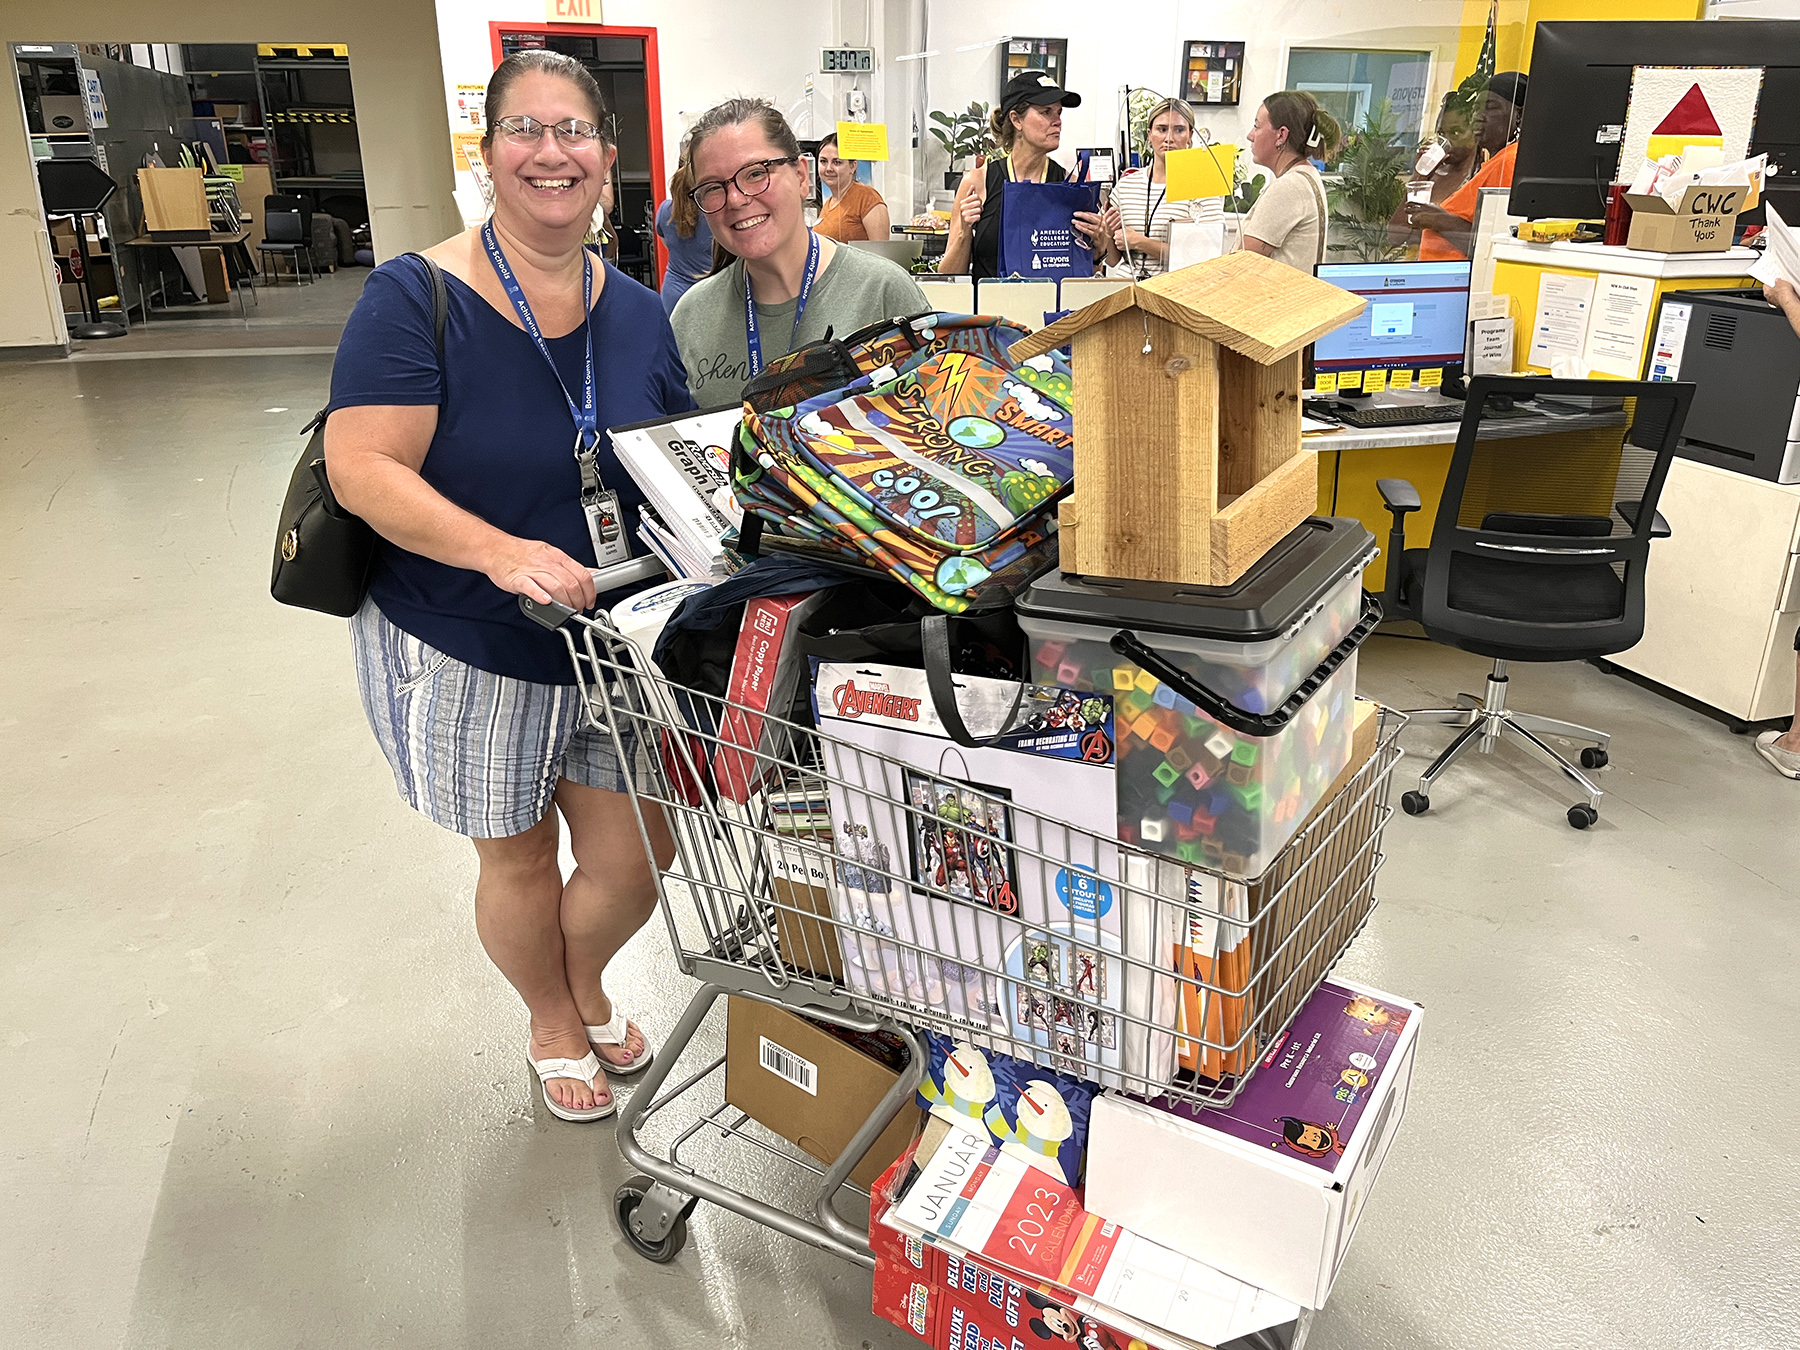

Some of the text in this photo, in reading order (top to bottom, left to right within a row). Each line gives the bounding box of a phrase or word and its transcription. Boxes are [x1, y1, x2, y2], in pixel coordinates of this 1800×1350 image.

[1692, 192, 1736, 214] CWC
[1689, 217, 1720, 228] Thank
[485, 228, 510, 280] County Schools
[808, 248, 818, 272] County
[802, 272, 813, 300] Schools
[518, 300, 540, 338] Achieving
[896, 379, 995, 476] STRONG
[996, 401, 1074, 449] SMART
[668, 440, 708, 486] Graph
[752, 640, 770, 692] Copy Paper
[832, 680, 922, 722] AVENGERS
[1018, 739, 1035, 748] FRAME
[1036, 735, 1068, 746] DECORATING
[792, 864, 806, 876] Pe
[1078, 879, 1088, 890] 6
[1280, 1059, 1291, 1069] Pre
[1336, 1087, 1350, 1102] PBS
[968, 1170, 984, 1192] MONDAY
[945, 1206, 962, 1229] SUNDAY
[1008, 1188, 1060, 1256] 2023
[1040, 1199, 1080, 1262] CALENDAR
[980, 1270, 988, 1292] and
[1124, 1268, 1134, 1280] 22
[1178, 1289, 1189, 1301] 29
[913, 1284, 928, 1335] CLUBHOUSE
[1006, 1296, 1020, 1328] GIFT
